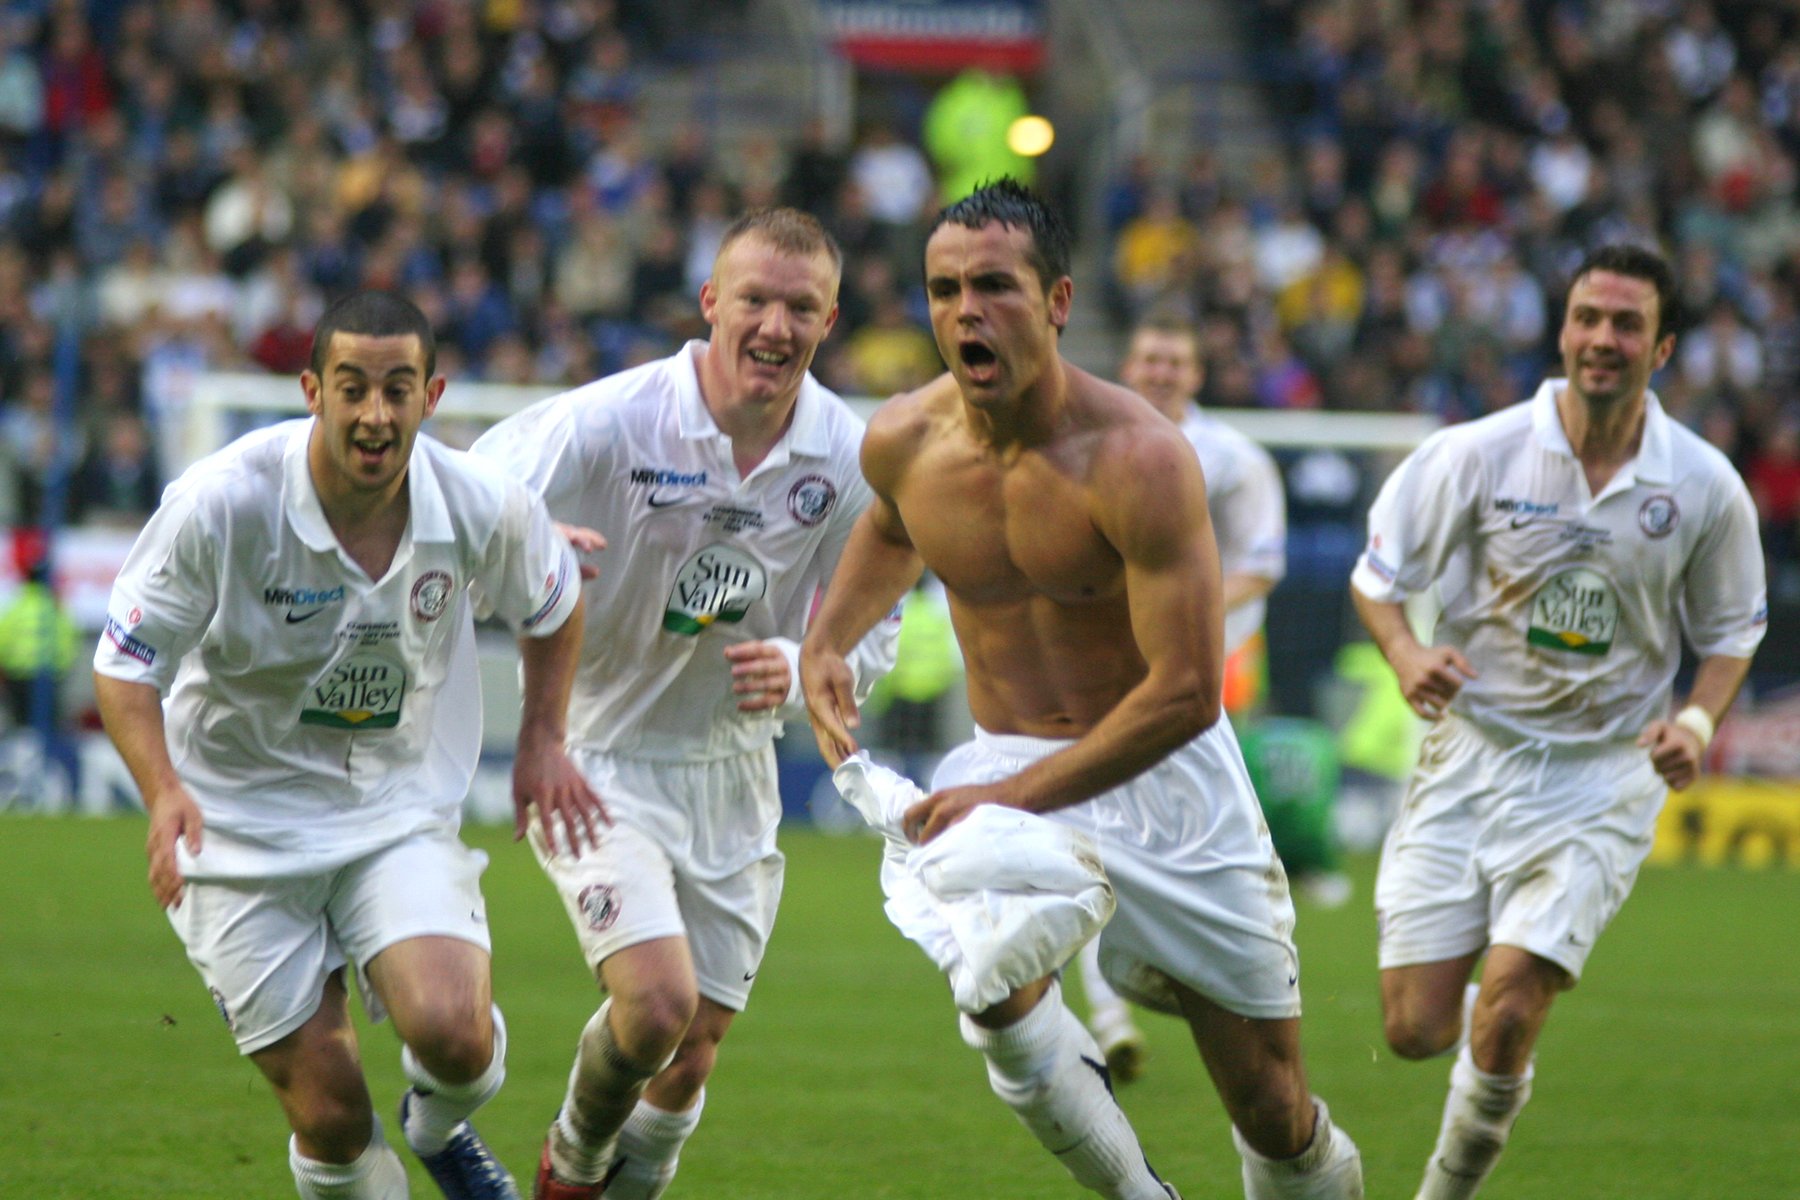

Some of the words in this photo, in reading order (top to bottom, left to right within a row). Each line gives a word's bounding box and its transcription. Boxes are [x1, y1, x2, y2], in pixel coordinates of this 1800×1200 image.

[692, 553, 750, 589] Sun
[1554, 577, 1604, 607] Sun
[328, 662, 388, 684] Sun
[316, 683, 397, 712] Valley
